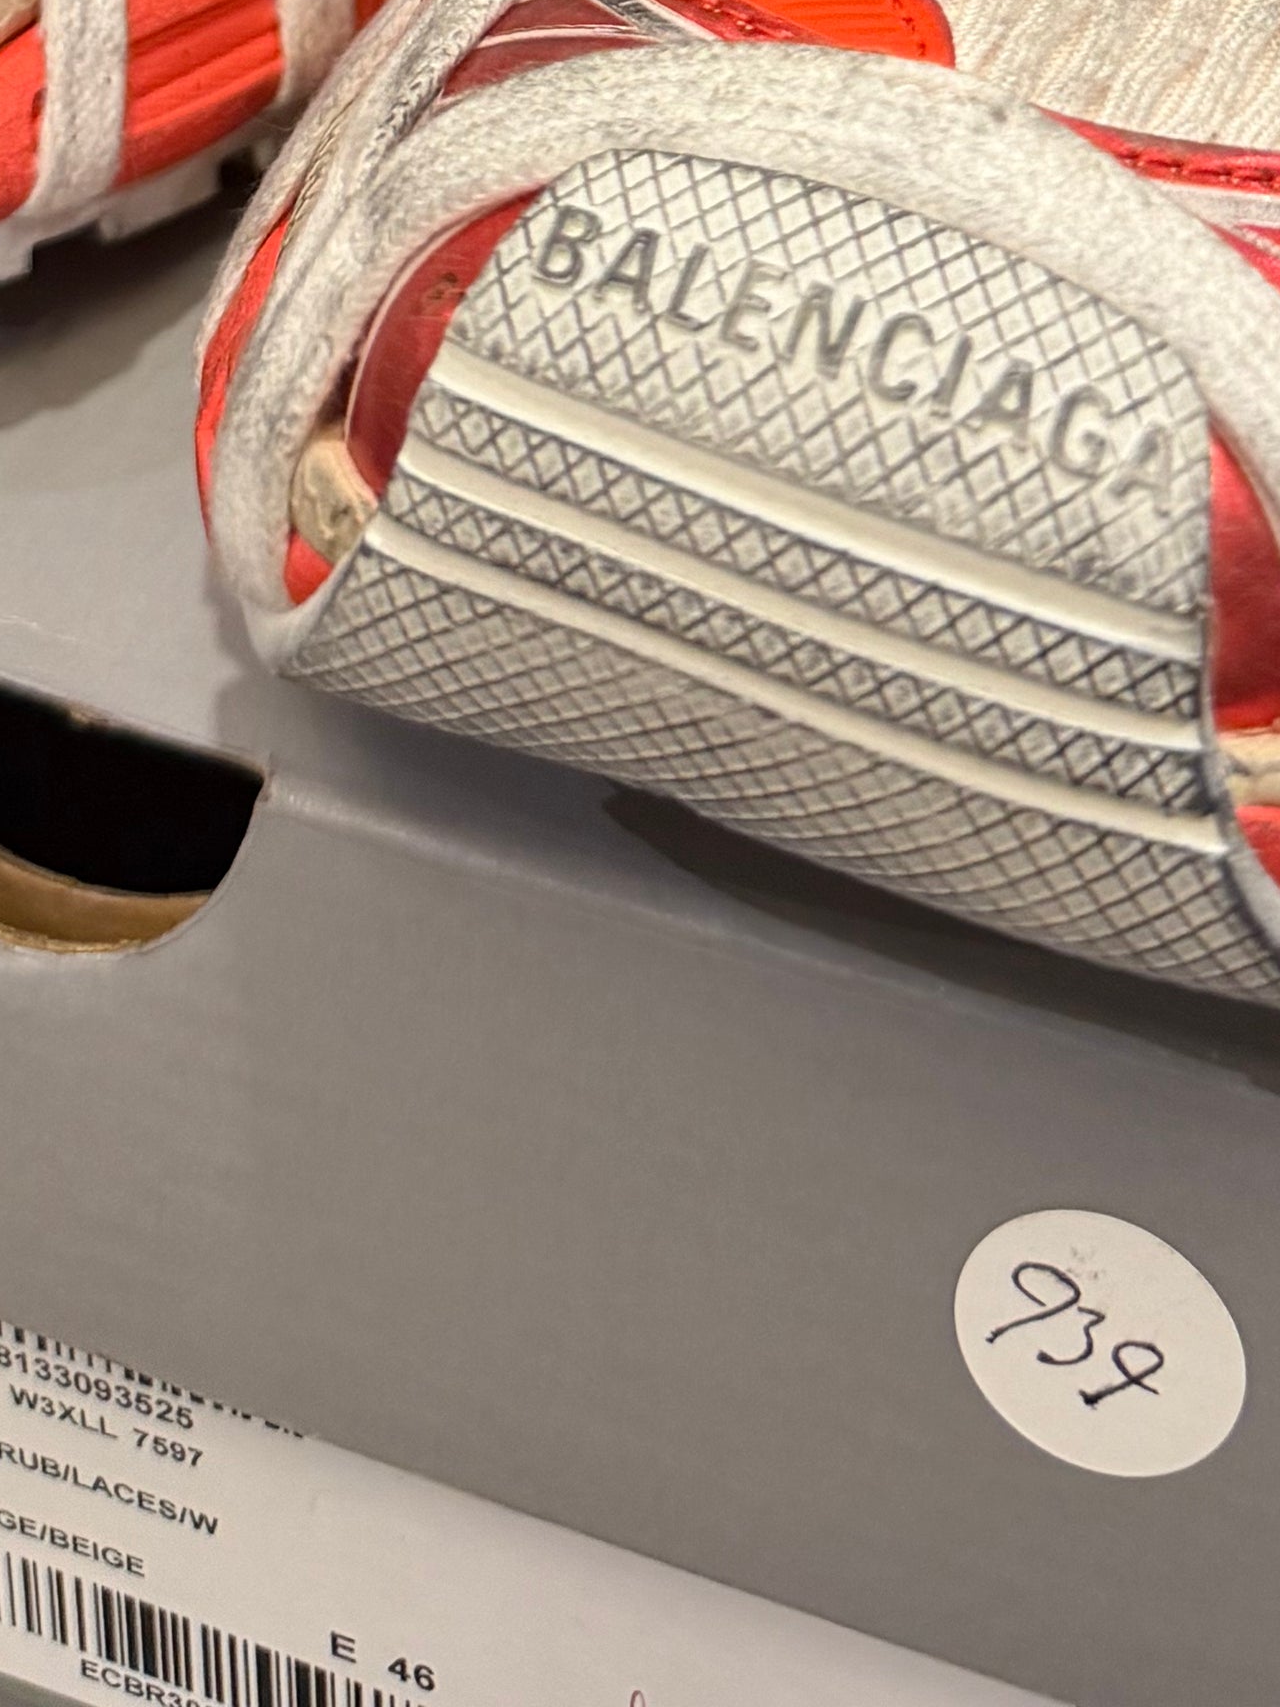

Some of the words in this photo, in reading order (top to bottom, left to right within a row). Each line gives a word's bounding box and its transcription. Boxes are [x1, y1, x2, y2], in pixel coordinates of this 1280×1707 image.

[532, 204, 1173, 517] BALENCIAGA
[9, 1383, 119, 1439] W3XLL
[133, 1427, 204, 1468] 7597
[330, 1630, 358, 1664] E
[387, 1657, 436, 1692] 46
